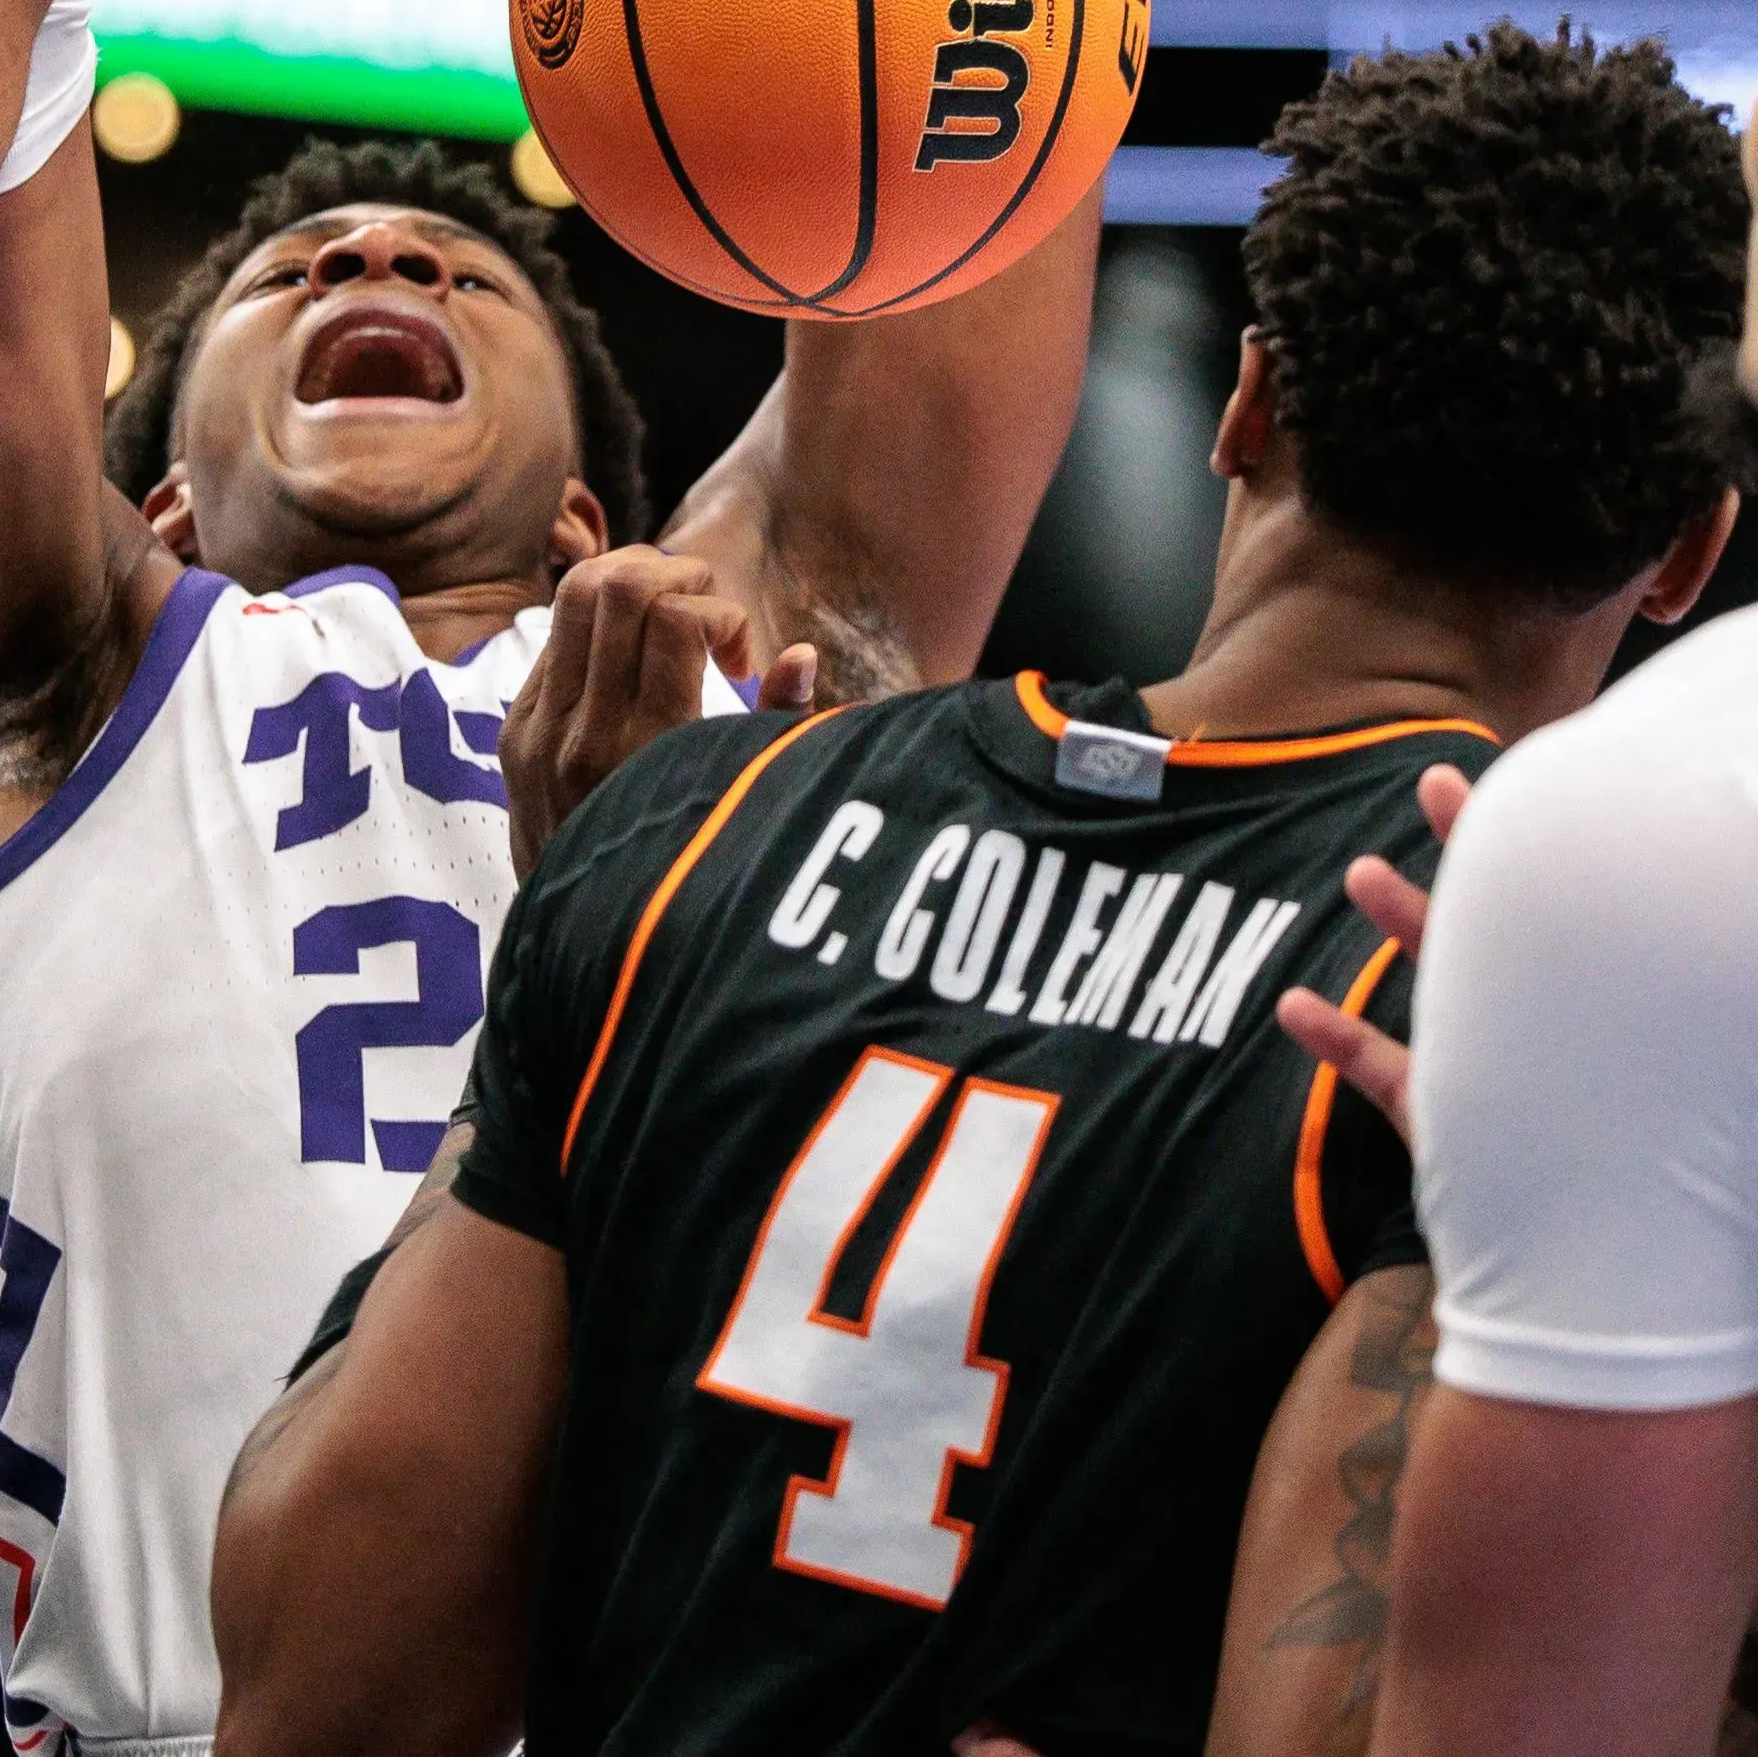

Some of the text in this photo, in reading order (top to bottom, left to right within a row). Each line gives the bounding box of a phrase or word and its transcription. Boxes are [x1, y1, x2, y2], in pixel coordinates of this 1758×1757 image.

[767, 801, 1301, 1050] C. COLEMAN
[695, 1044, 1062, 1613] 4
